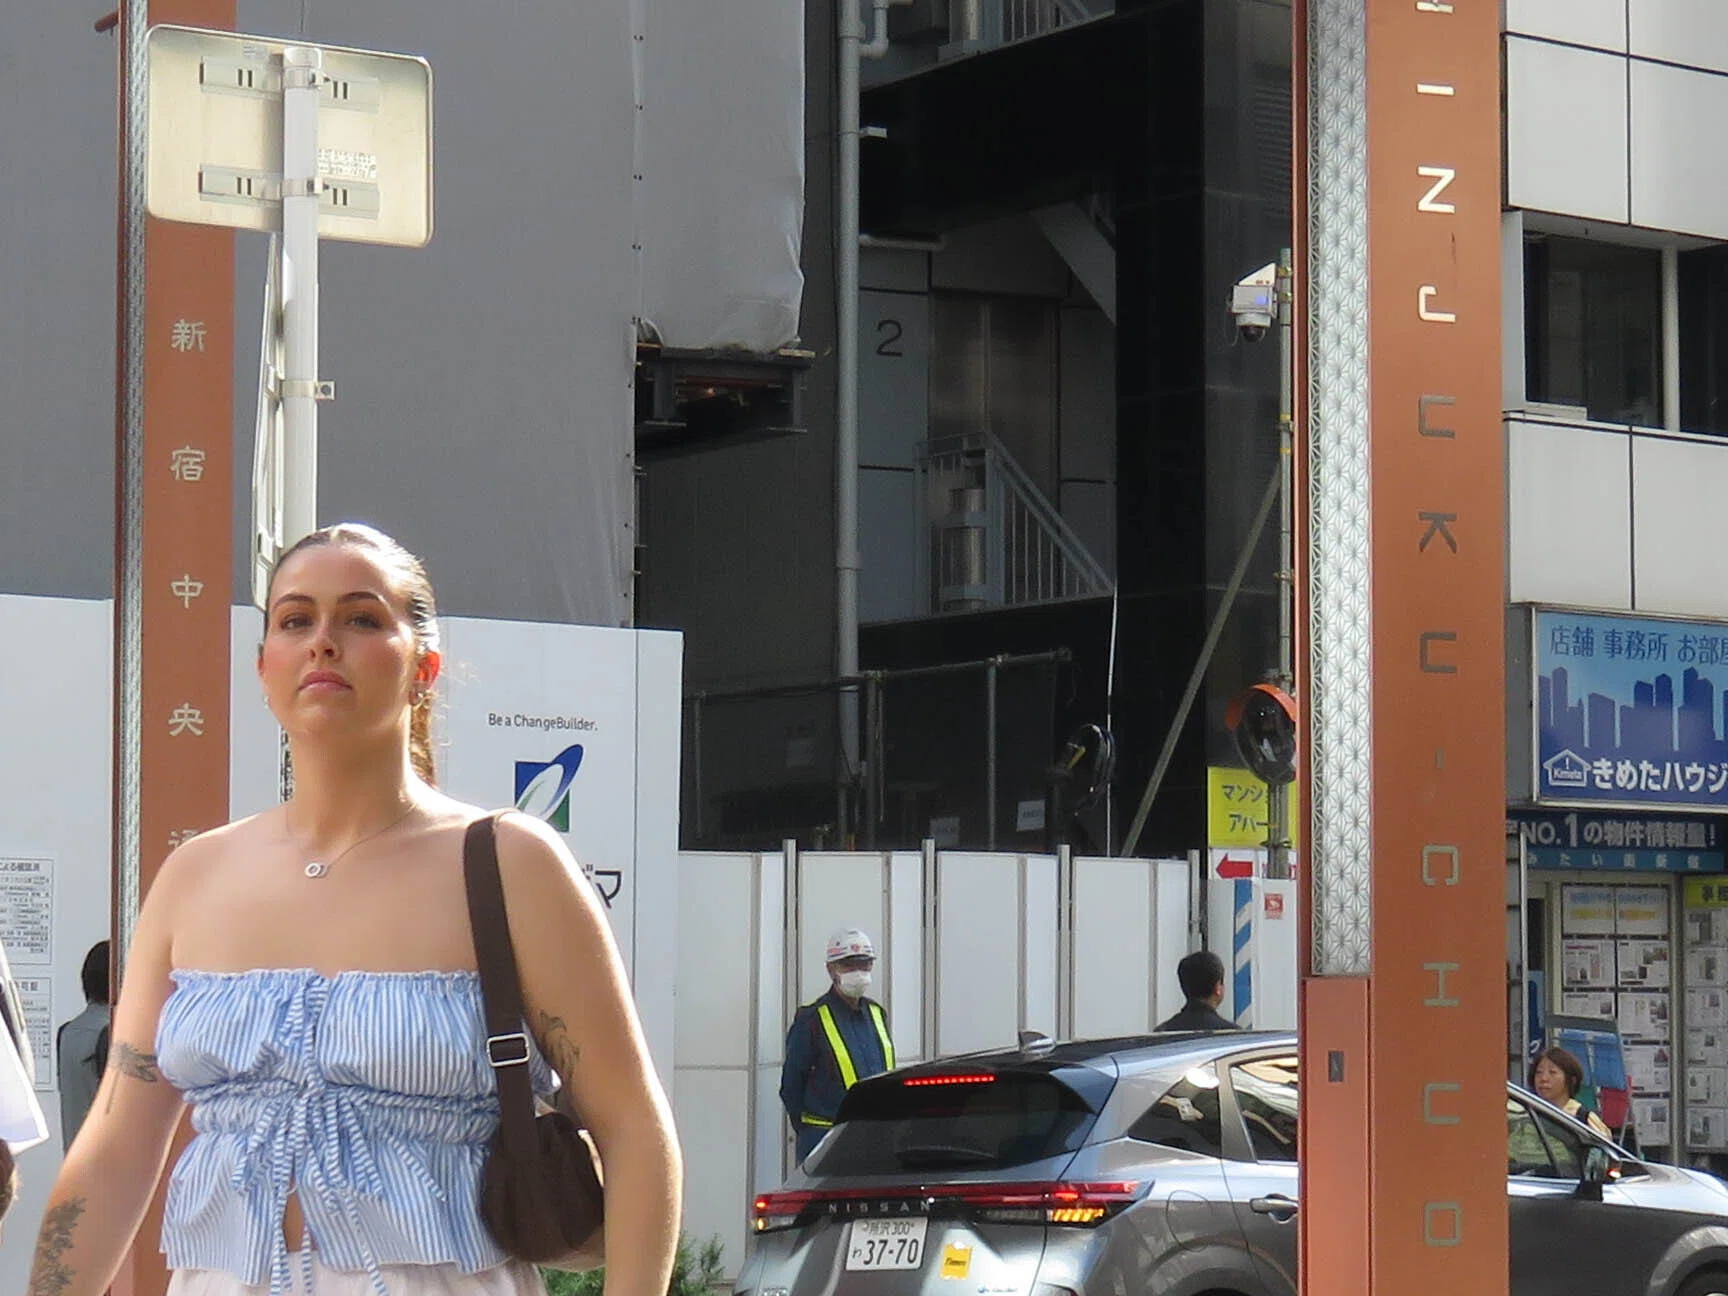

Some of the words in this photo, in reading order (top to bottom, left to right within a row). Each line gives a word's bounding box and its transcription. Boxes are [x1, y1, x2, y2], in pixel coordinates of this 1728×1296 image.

[875, 319, 904, 357] 2
[1550, 624, 1595, 657] 店舗
[1603, 629, 1669, 663] 事務所
[488, 712, 504, 727] Be
[505, 715, 512, 727] a
[513, 713, 600, 733] ChangeBuilder.
[1222, 784, 1269, 803] マンシ
[828, 1200, 932, 1214] NISSAN
[863, 1237, 920, 1266] 37-70
